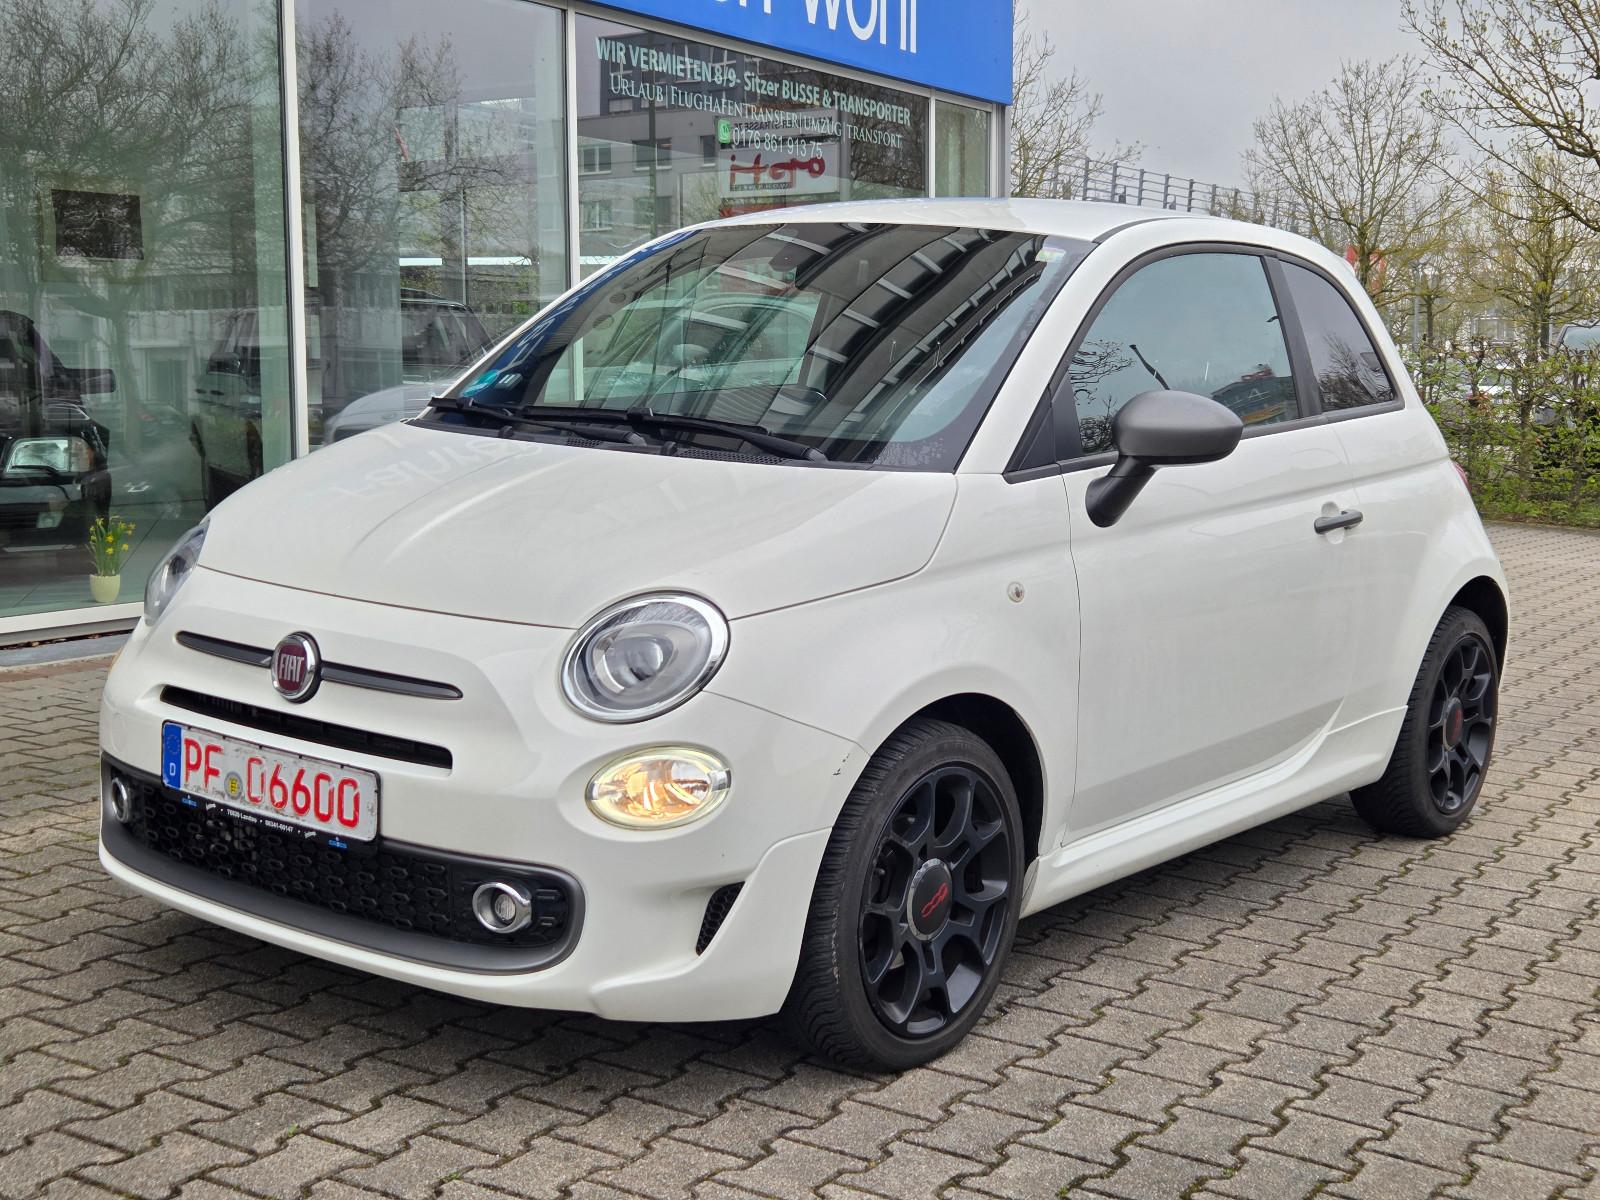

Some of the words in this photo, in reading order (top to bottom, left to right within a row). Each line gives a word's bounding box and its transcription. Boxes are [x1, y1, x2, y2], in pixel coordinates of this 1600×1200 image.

[595, 37, 626, 65] WIR
[629, 44, 712, 83] VERMIETEN
[744, 71, 780, 97] Sitzer
[782, 79, 820, 106] BUSSE
[822, 89, 832, 108] &
[832, 90, 911, 126] TRANSPORTER
[610, 73, 664, 102] URLAUB
[671, 85, 799, 129] FLUGHAFENTRANSFER
[804, 115, 842, 137] UMZUG
[847, 123, 903, 148] TRANSPORT
[732, 127, 761, 149] 0176
[764, 132, 783, 153] 861
[787, 136, 807, 157] 913
[809, 141, 823, 159] 75
[279, 653, 304, 683] FIAT
[169, 762, 176, 776] D
[184, 737, 225, 789] PF
[246, 756, 361, 829] 06600
